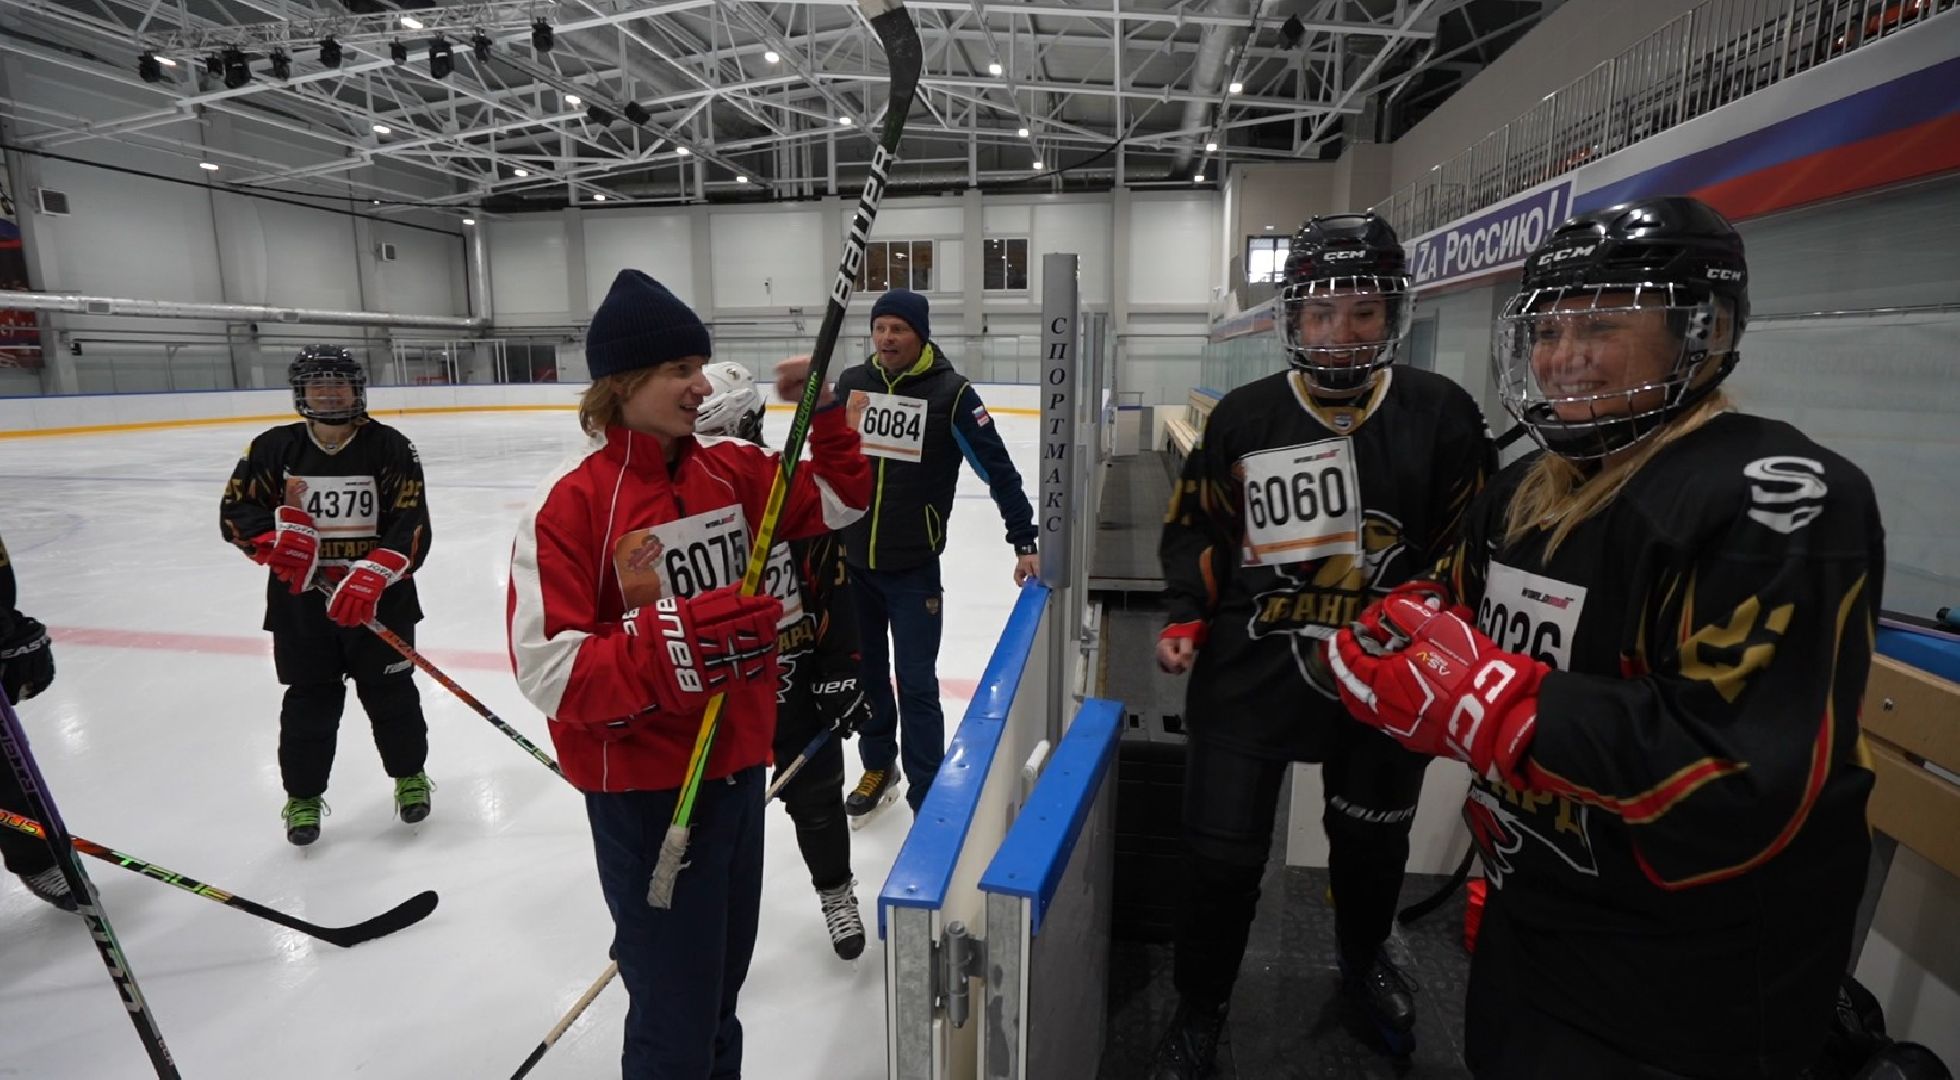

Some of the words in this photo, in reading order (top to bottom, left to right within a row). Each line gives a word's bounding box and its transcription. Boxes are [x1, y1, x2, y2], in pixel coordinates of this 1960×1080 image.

[1322, 249, 1367, 262] CCM
[1537, 244, 1597, 266] CCM
[1706, 268, 1744, 282] CCM
[864, 406, 922, 442] 6084
[1045, 317, 1068, 533] СПОРТМАКС
[307, 490, 374, 519] 4379
[1250, 467, 1347, 530] 6060
[665, 530, 748, 599] 6075
[765, 559, 799, 600] 22
[811, 678, 857, 695] UER
